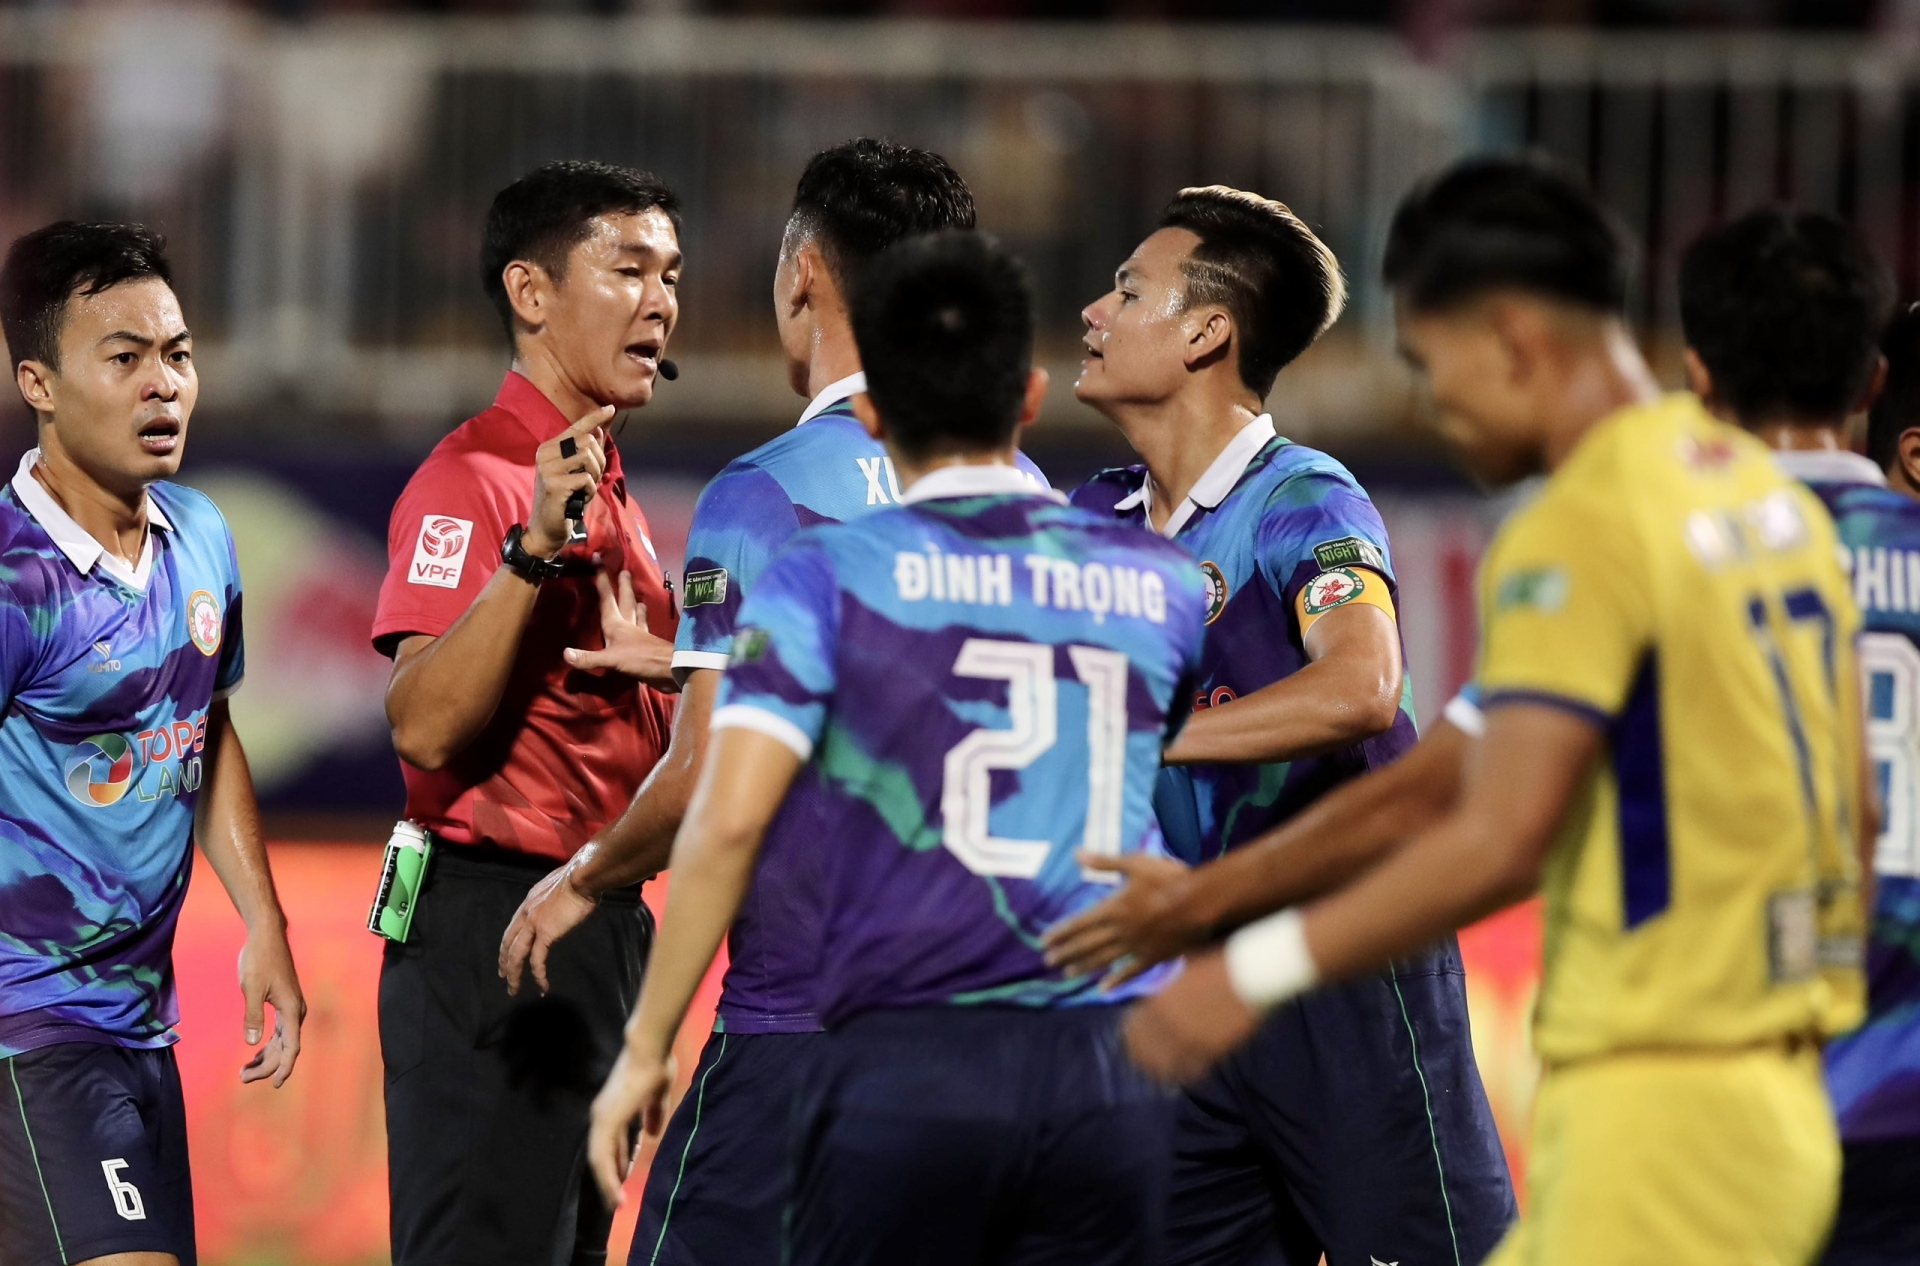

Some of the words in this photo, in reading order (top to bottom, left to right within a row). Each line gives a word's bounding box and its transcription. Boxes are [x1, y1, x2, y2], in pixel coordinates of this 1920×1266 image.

[416, 562, 458, 581] VPF
[1320, 545, 1357, 564] NIGHT
[894, 541, 1012, 606] ĐÌNH
[1024, 554, 1167, 626] TRỌNG
[137, 714, 208, 768] TOPE
[940, 638, 1128, 886] 21
[136, 756, 203, 802] LAND
[101, 1158, 147, 1220] 6
